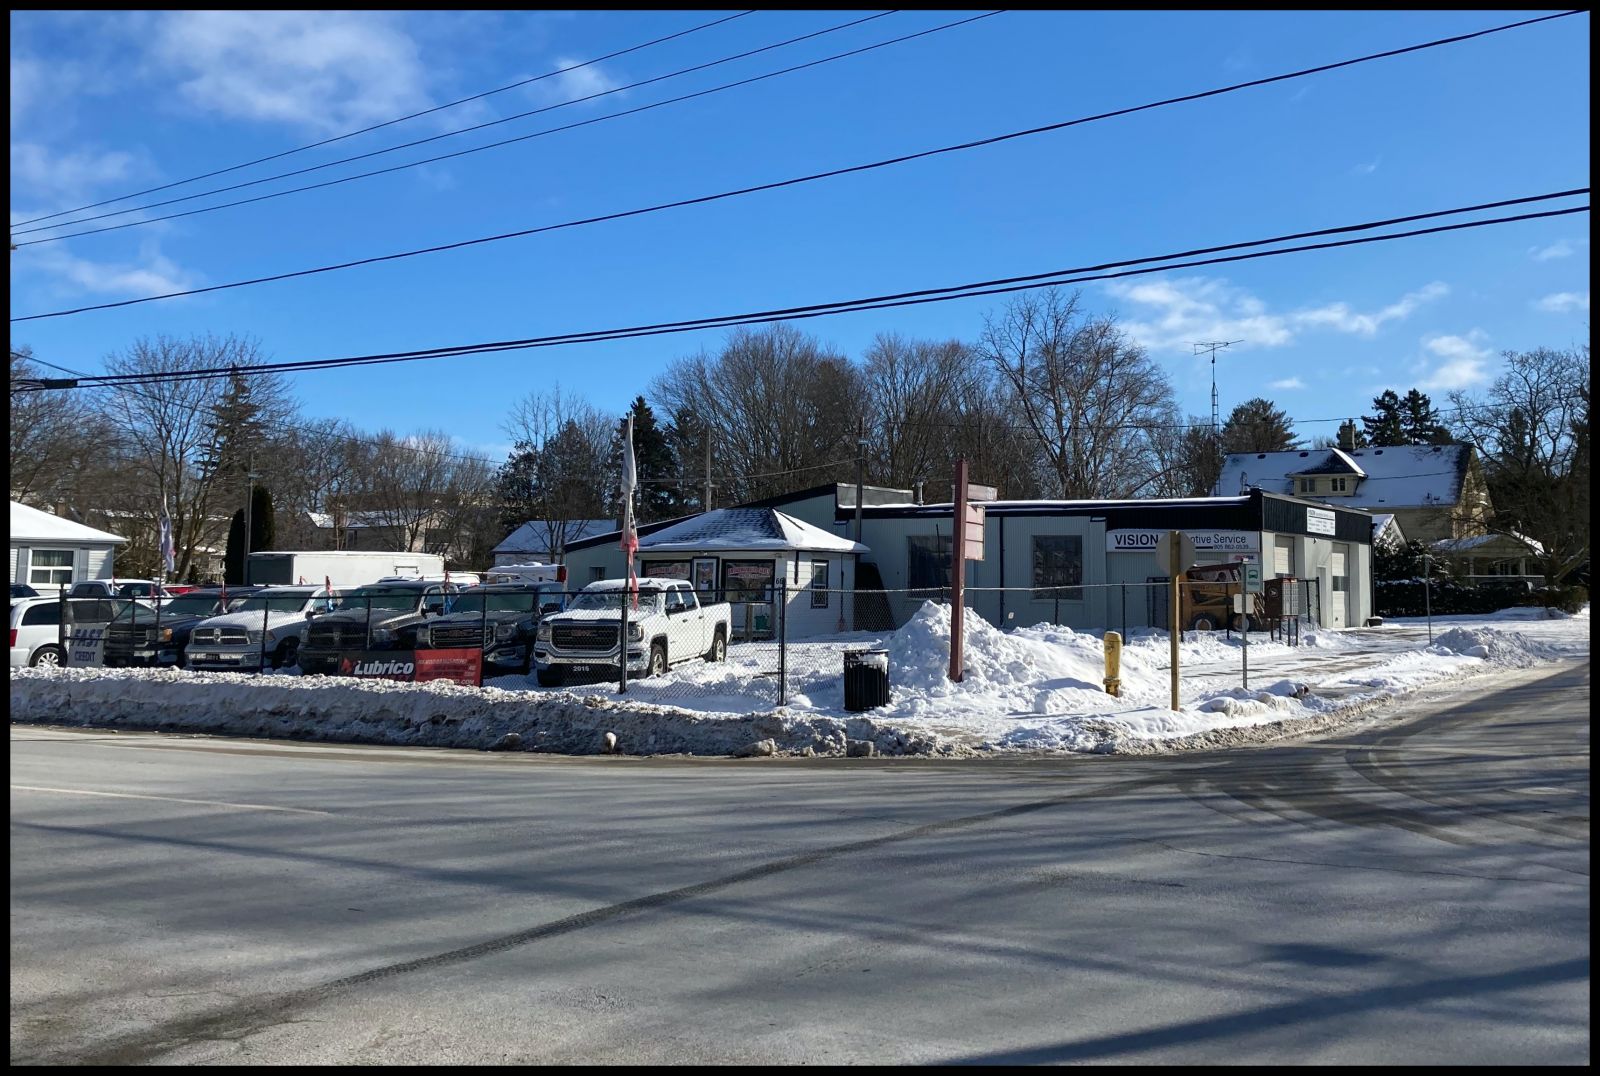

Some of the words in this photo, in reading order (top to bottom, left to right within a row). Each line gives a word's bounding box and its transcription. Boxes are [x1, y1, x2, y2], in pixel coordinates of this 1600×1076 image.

[1115, 534, 1159, 546] VISION
[1213, 534, 1247, 544] Service
[70, 628, 105, 648] FAST
[354, 660, 414, 675] Lubrico
